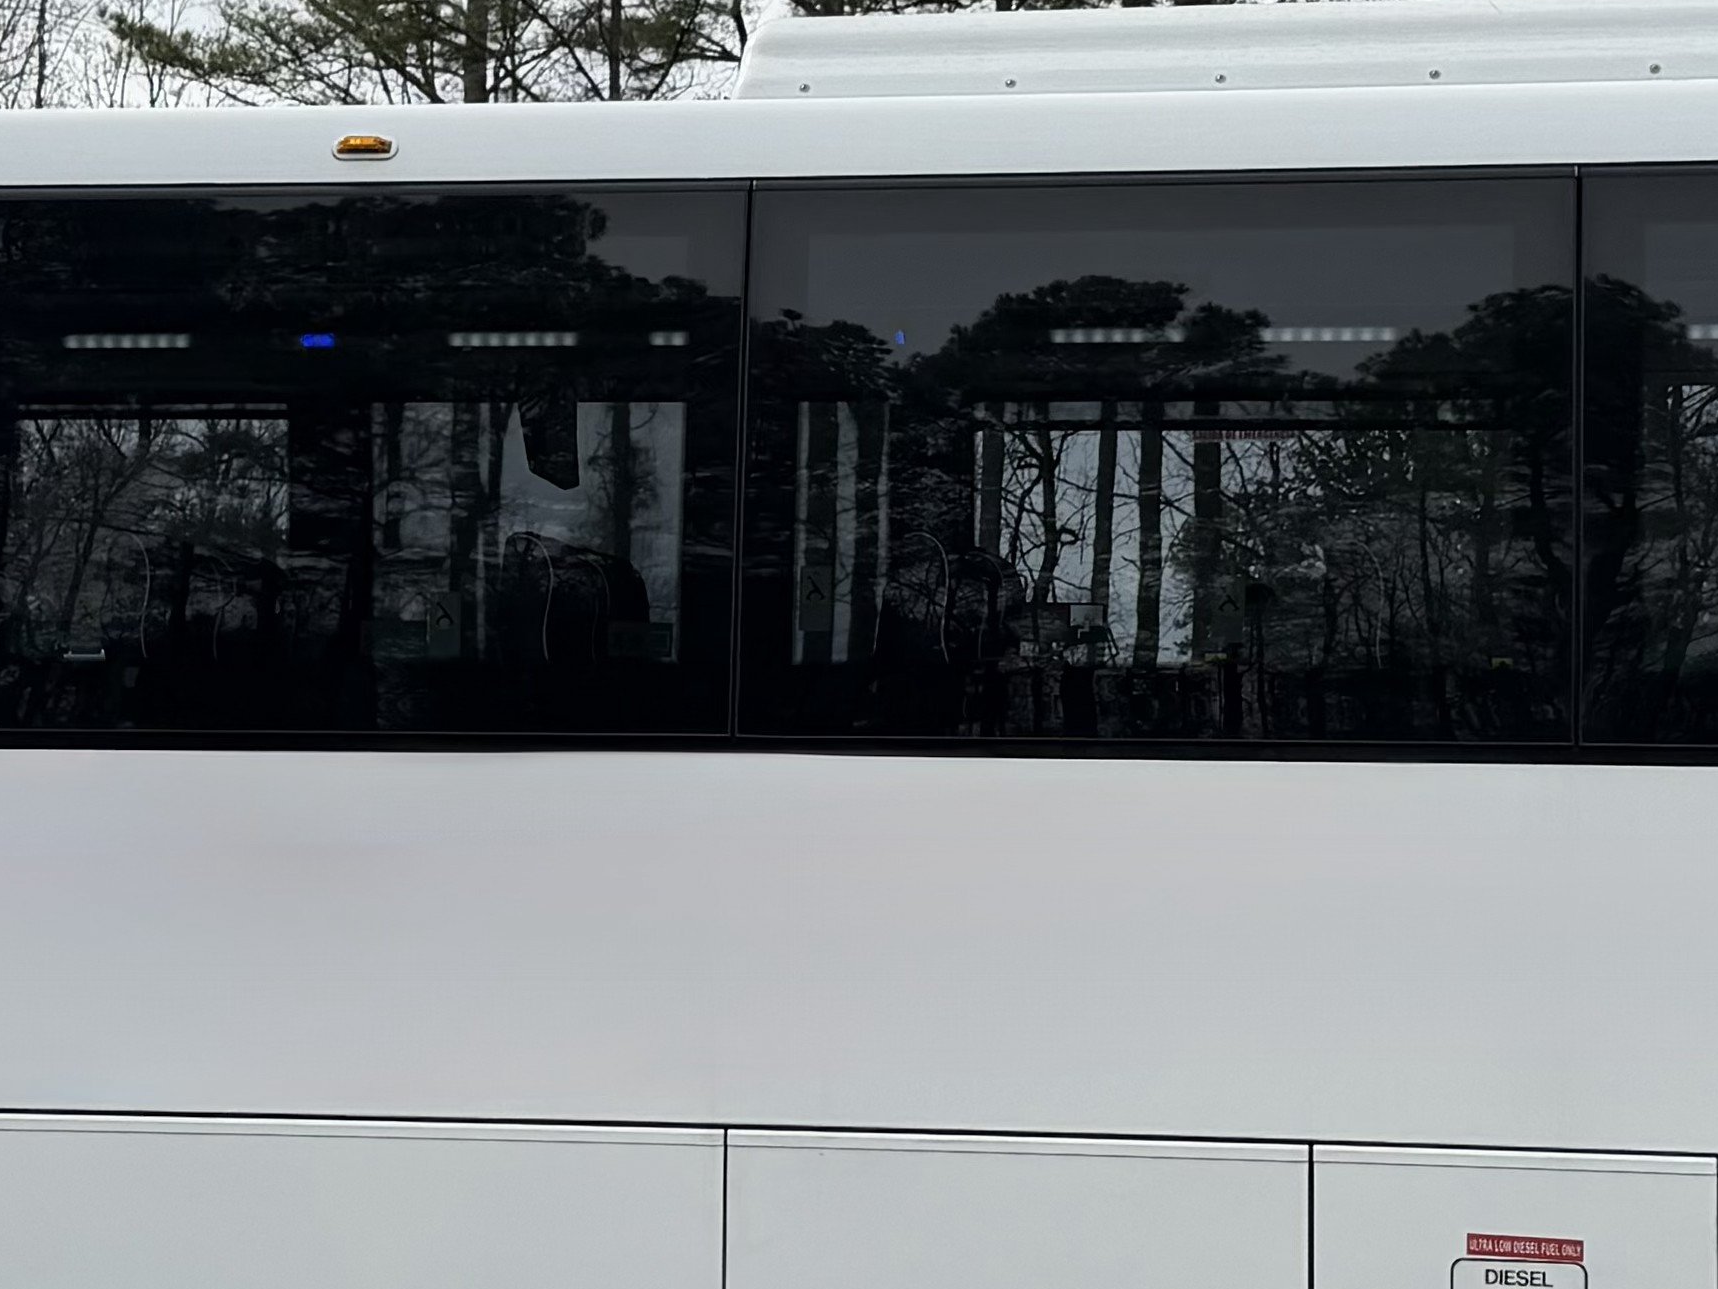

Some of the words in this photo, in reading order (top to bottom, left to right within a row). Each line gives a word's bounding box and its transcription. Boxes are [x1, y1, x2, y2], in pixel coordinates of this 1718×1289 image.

[1469, 1238, 1494, 1252] ULTRA
[1494, 1239, 1512, 1253] LOW
[1513, 1240, 1540, 1255] DIESEL
[1541, 1242, 1561, 1256] FUEL
[1562, 1243, 1582, 1257] ONLY
[1485, 1269, 1554, 1287] DIESEL
